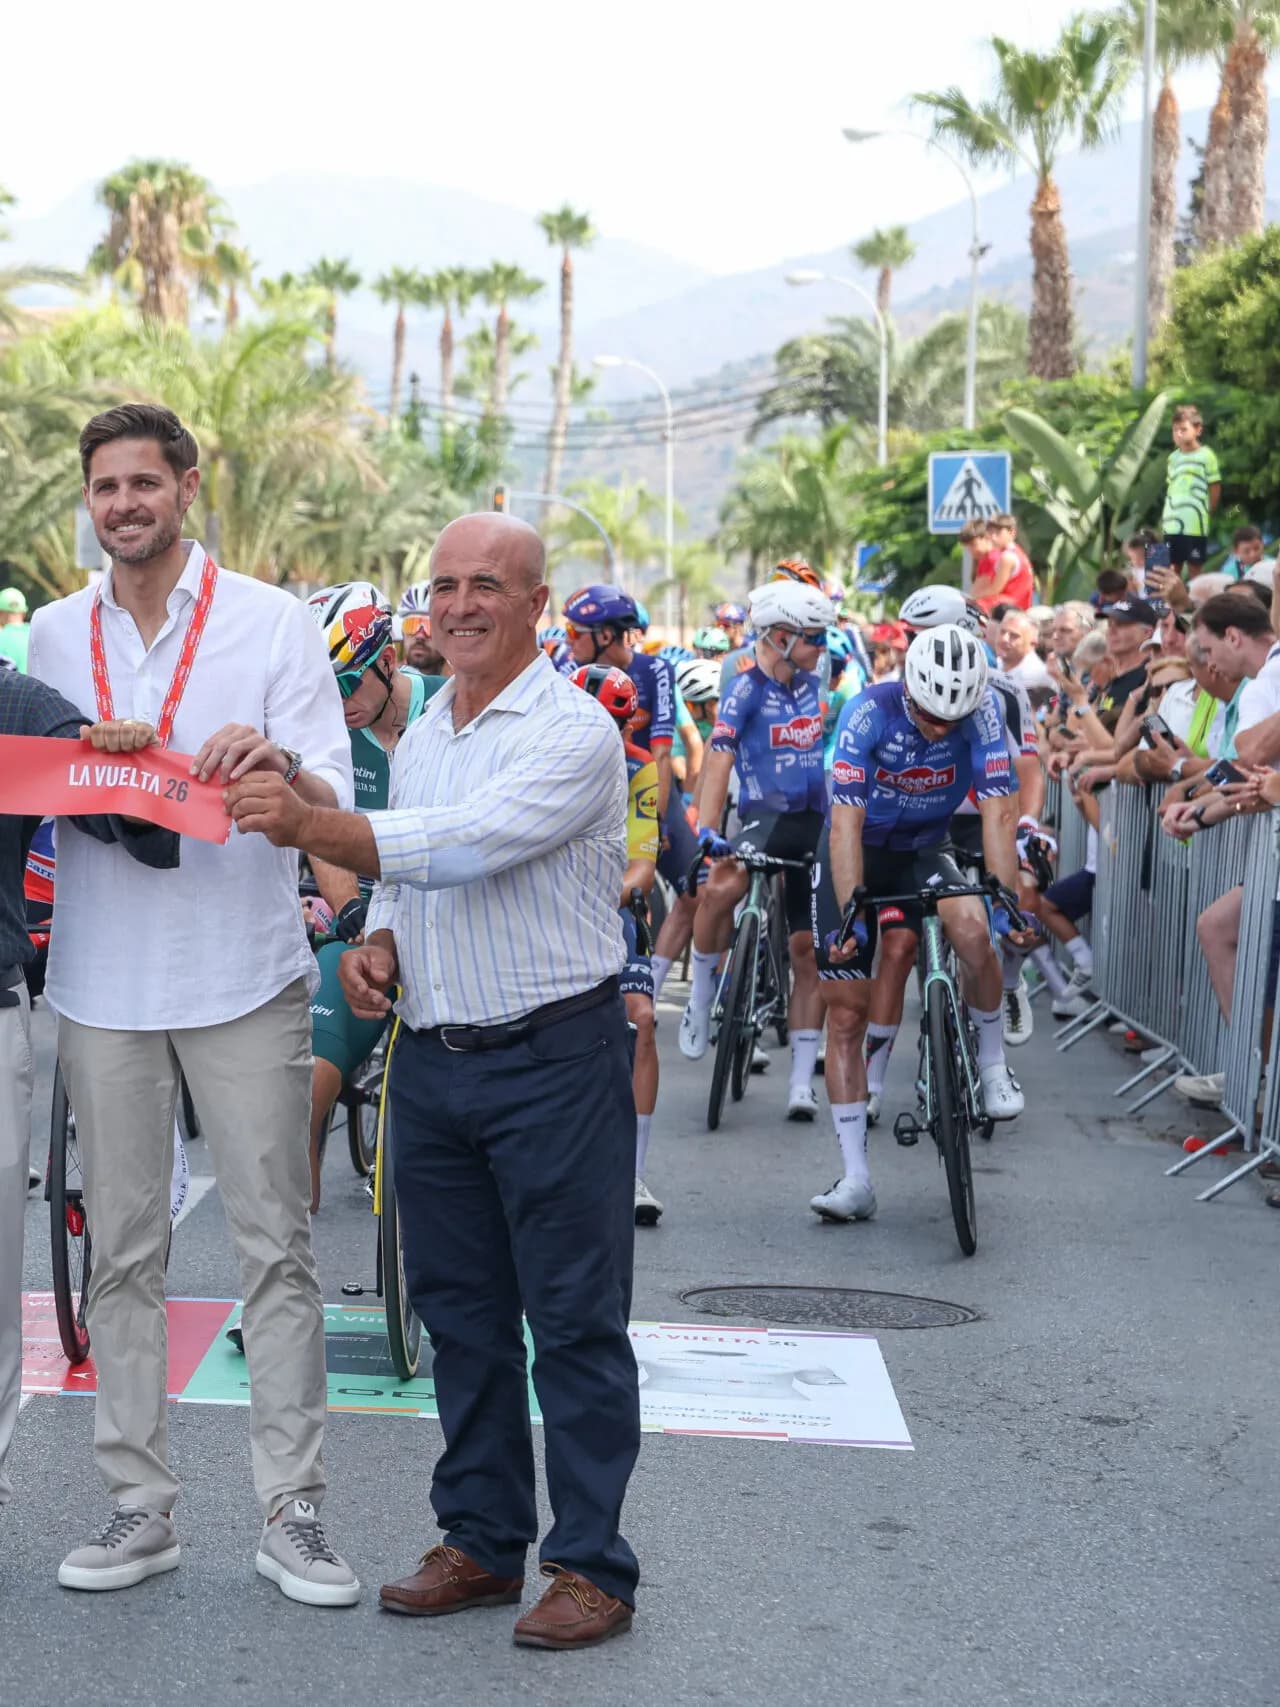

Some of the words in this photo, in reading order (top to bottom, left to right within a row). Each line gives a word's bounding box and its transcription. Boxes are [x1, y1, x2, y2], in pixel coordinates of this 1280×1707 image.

[847, 699, 878, 730] PREMIER
[68, 764, 91, 786] LA
[94, 765, 161, 796] VUELTA
[163, 778, 190, 803] 26
[885, 772, 949, 787] Alpecin
[667, 1334, 761, 1345] VUELTA
[767, 1340, 799, 1348] 26
